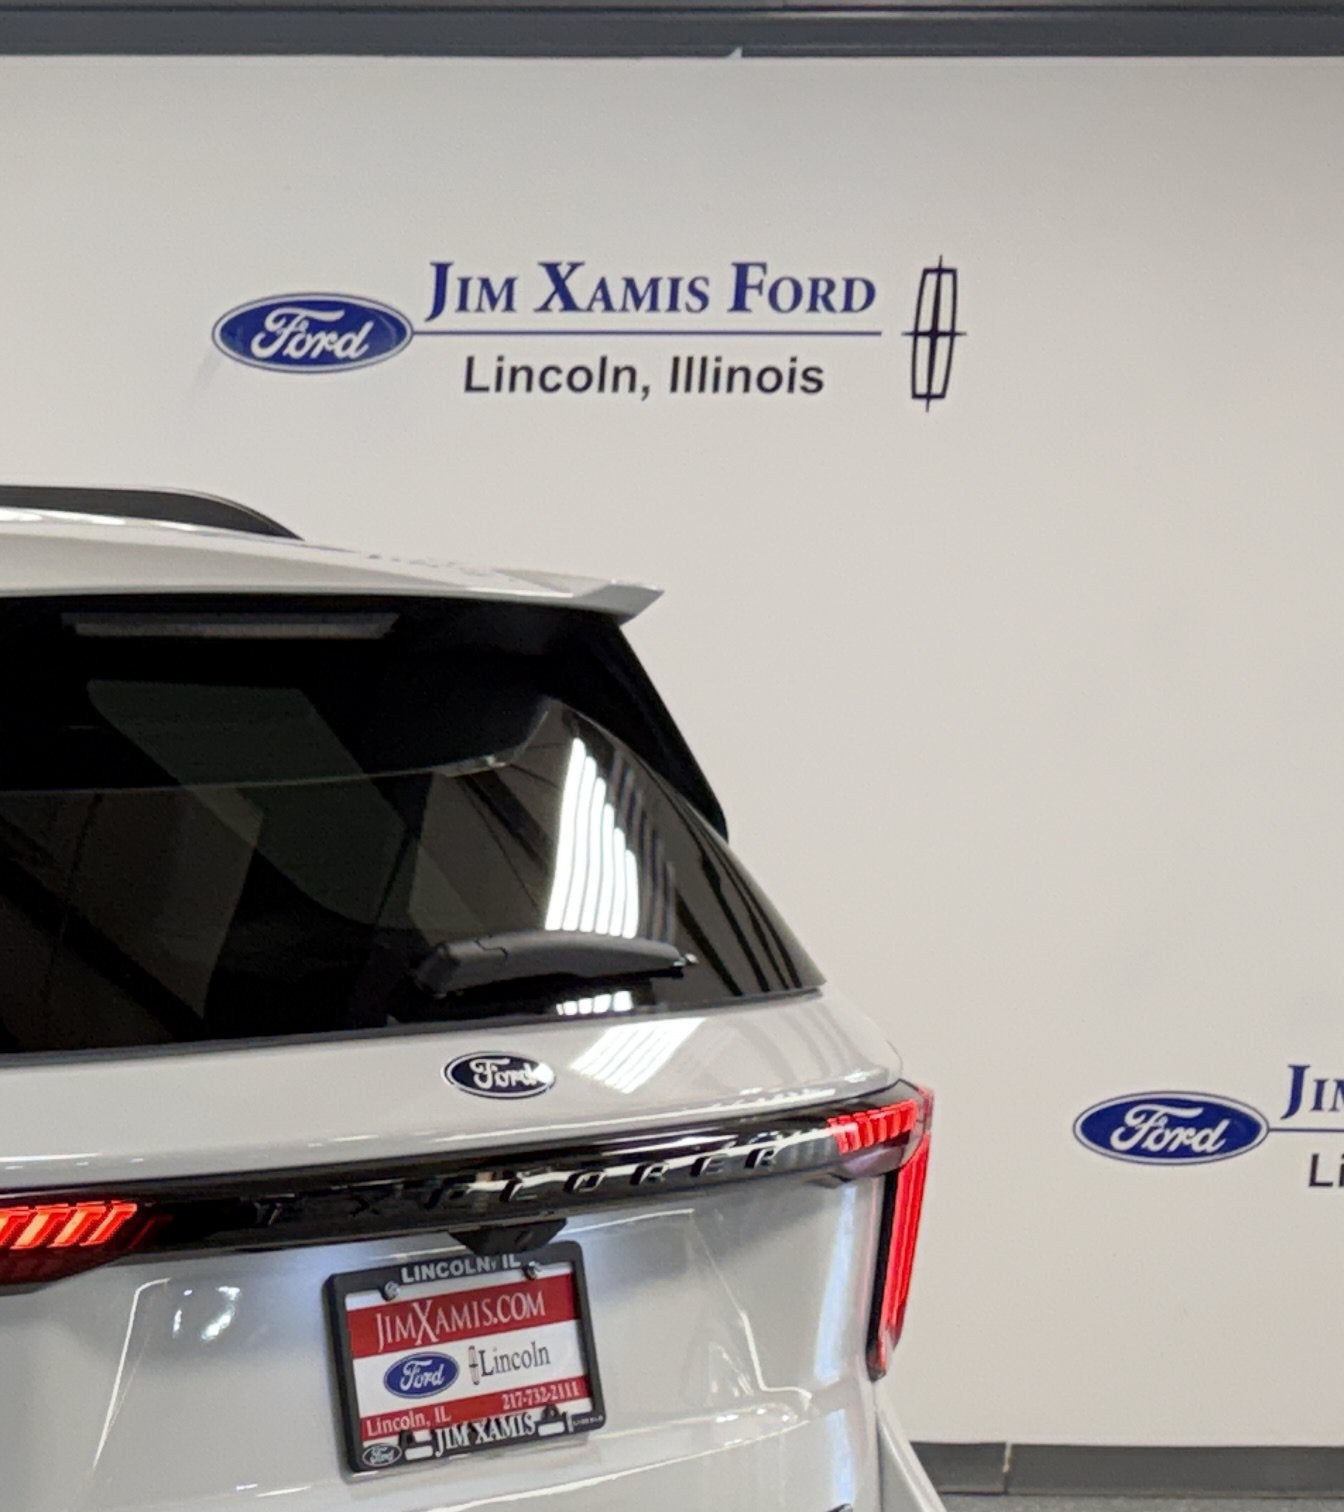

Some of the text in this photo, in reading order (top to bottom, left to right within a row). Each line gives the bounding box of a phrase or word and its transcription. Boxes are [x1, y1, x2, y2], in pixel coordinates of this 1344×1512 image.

[424, 261, 877, 322] JIM XAMIS FORD
[251, 305, 369, 361] Ford
[464, 354, 825, 400] Lincoln, Illinois
[469, 1058, 538, 1089] Ford
[1110, 1103, 1232, 1153] Ford
[401, 1255, 497, 1284] LINCOLN,
[375, 1290, 546, 1353] JIMXAMIS.COM
[399, 1360, 445, 1391] Ford
[478, 1341, 552, 1378] Lincoln
[434, 1406, 453, 1423] IL
[434, 1412, 537, 1457] JIM XAMIS
